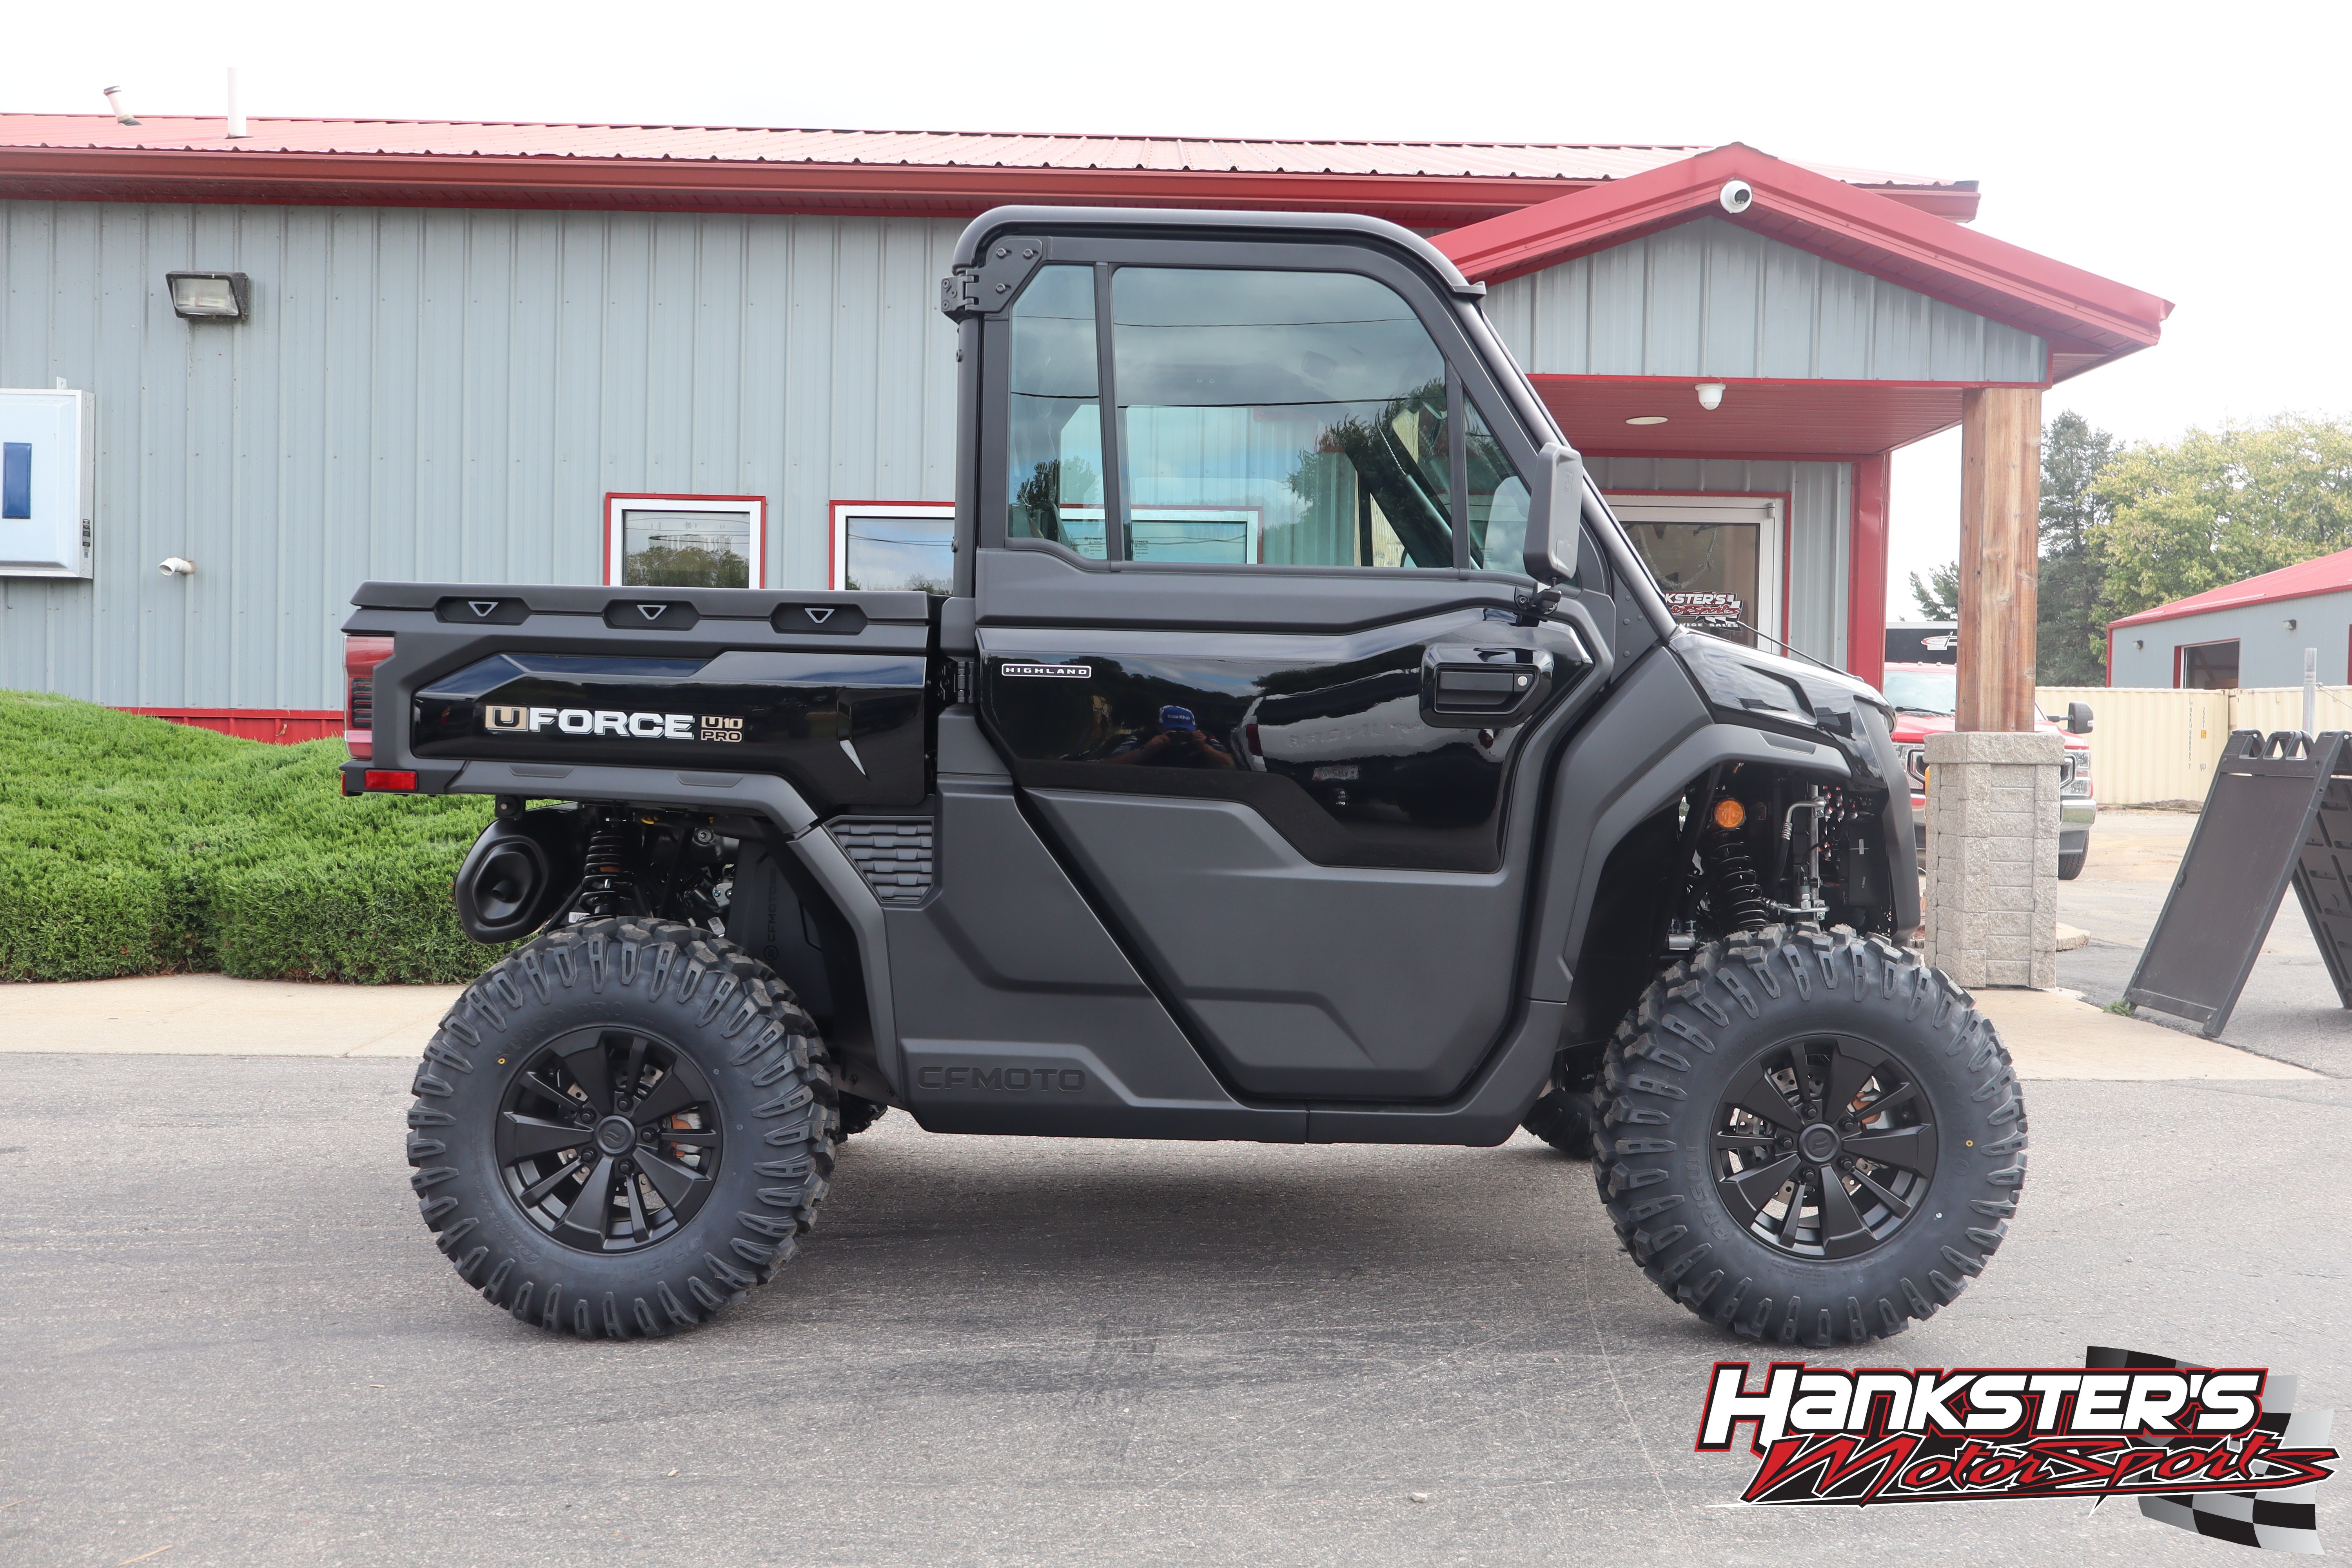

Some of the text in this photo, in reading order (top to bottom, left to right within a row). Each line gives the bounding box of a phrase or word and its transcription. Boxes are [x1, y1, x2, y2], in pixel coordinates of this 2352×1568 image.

[1662, 593, 1726, 605] KSTER'S
[486, 706, 743, 740] UFORCE U10
[701, 730, 742, 742] PRO
[574, 1001, 625, 1020] PRO
[918, 1066, 1085, 1092] CFMOTO
[1685, 1146, 1728, 1241] ARISUN
[610, 1234, 705, 1283] ARISUN
